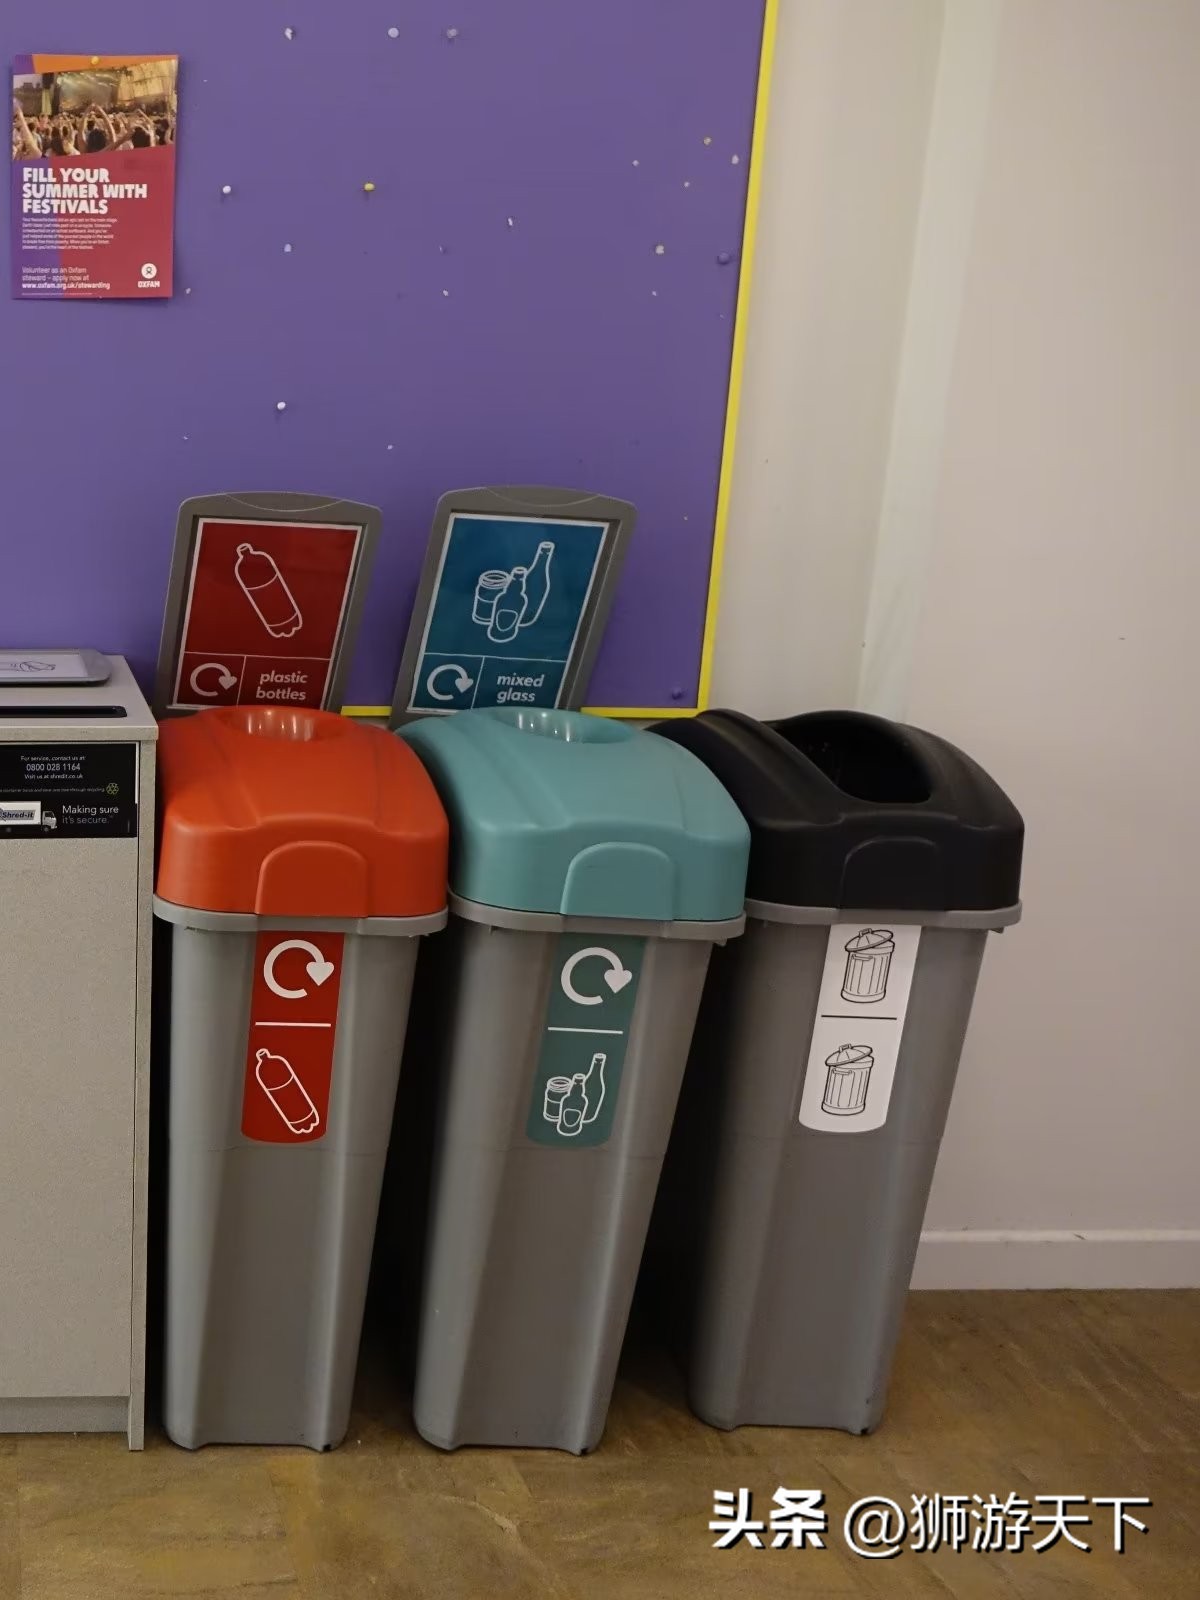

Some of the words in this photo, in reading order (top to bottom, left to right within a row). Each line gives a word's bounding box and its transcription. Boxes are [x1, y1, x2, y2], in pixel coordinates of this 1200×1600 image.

[23, 167, 56, 183] FILL
[60, 168, 109, 183] YOUR
[22, 183, 99, 199] SUMMER
[103, 184, 147, 198] WITH
[23, 199, 108, 214] FESTIVALS
[22, 266, 50, 274] Volunteer
[52, 275, 68, 283] apply
[21, 281, 110, 290] www.oxfam.org.uk/stewarding
[259, 670, 308, 685] plastic
[496, 672, 545, 687] mixed
[255, 686, 306, 700] bottles
[496, 688, 536, 703] glass
[26, 763, 44, 771] 0800
[46, 763, 60, 771] 028
[63, 763, 81, 771] 1164
[2, 811, 34, 819] Shred-it
[62, 805, 97, 815] Making
[99, 806, 119, 814] sure
[62, 815, 74, 824] it's
[77, 816, 109, 824] secure.
